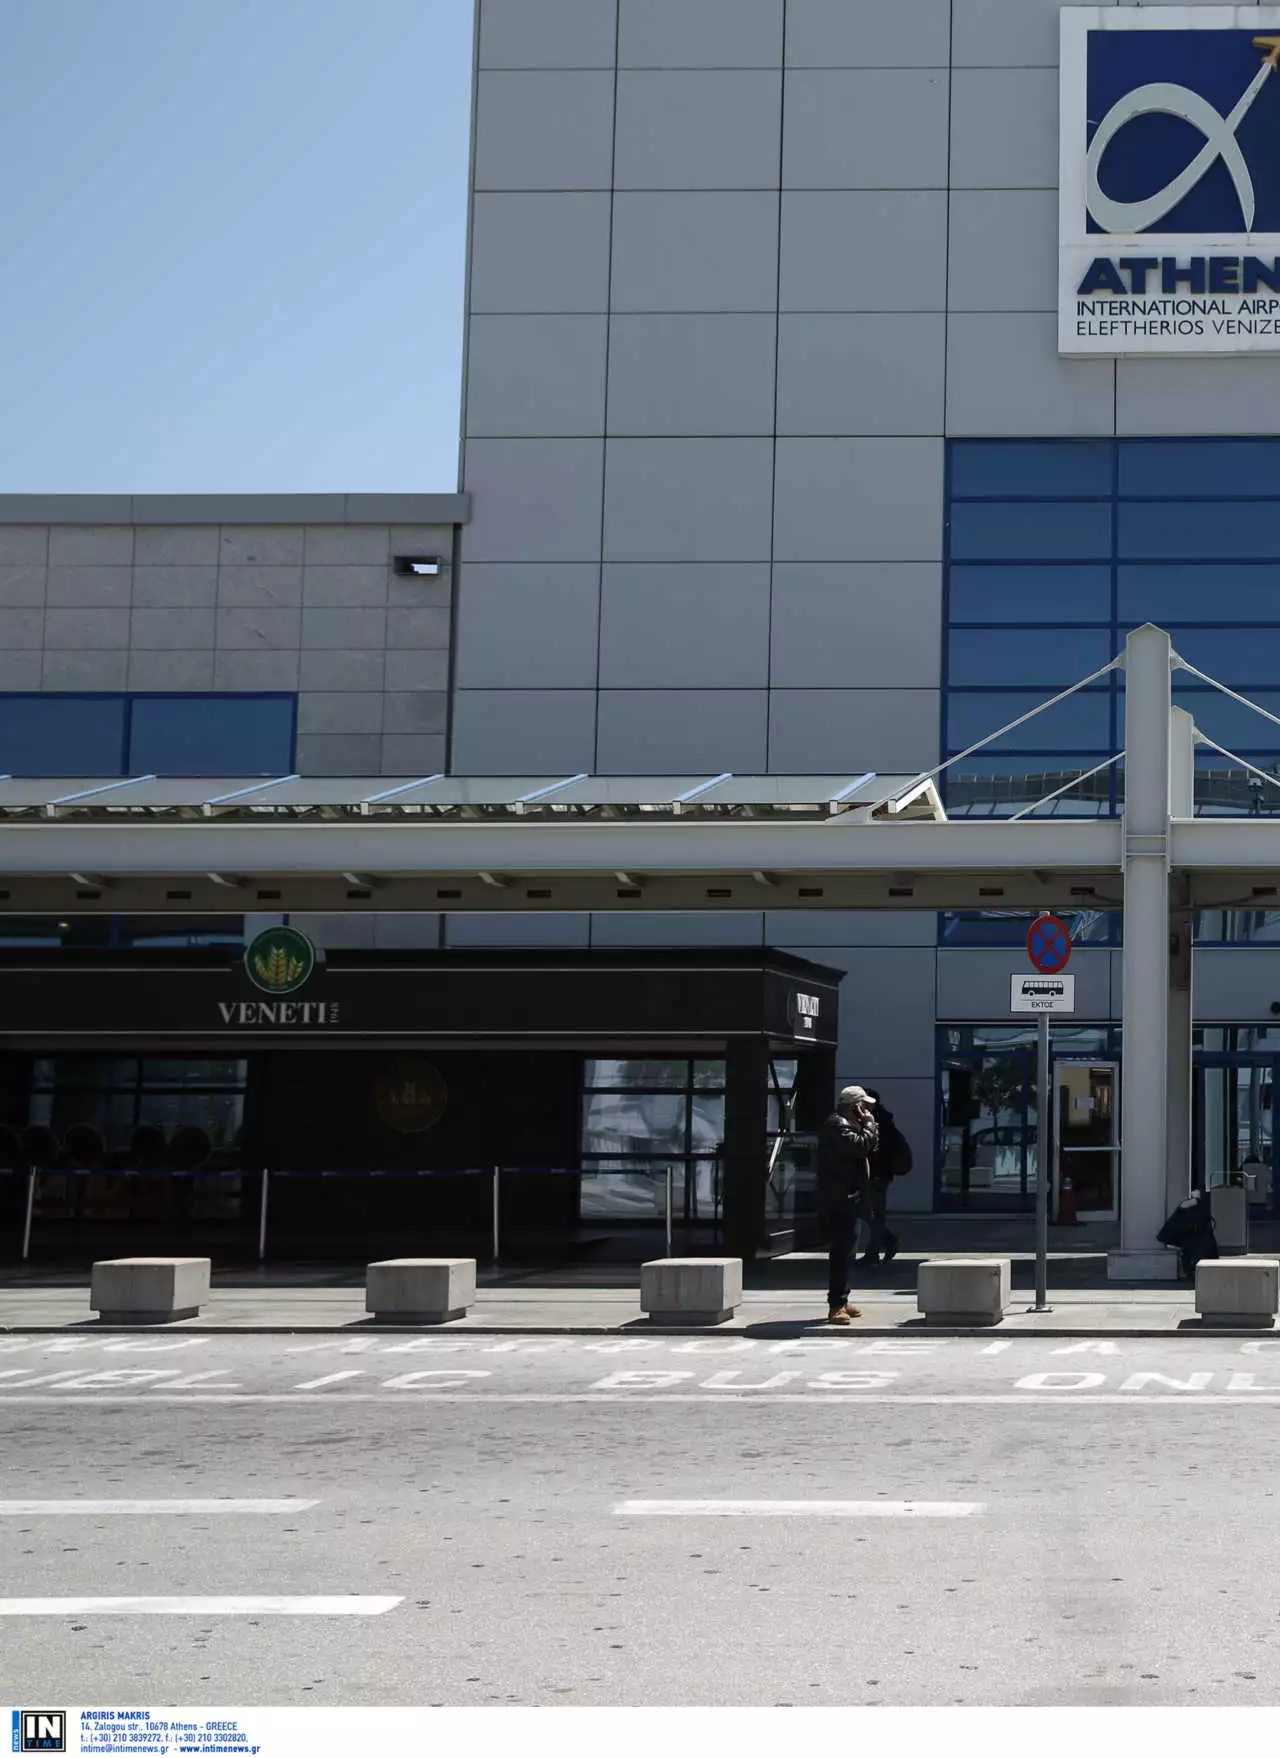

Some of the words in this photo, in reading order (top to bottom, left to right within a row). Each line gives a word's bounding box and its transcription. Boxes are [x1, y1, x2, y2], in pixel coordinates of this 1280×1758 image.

[1077, 300, 1232, 316] INTERNATIONAL
[1077, 320, 1204, 335] ELEFTHERIOS
[217, 1001, 327, 1025] VENETI
[588, 1369, 902, 1390] BUS
